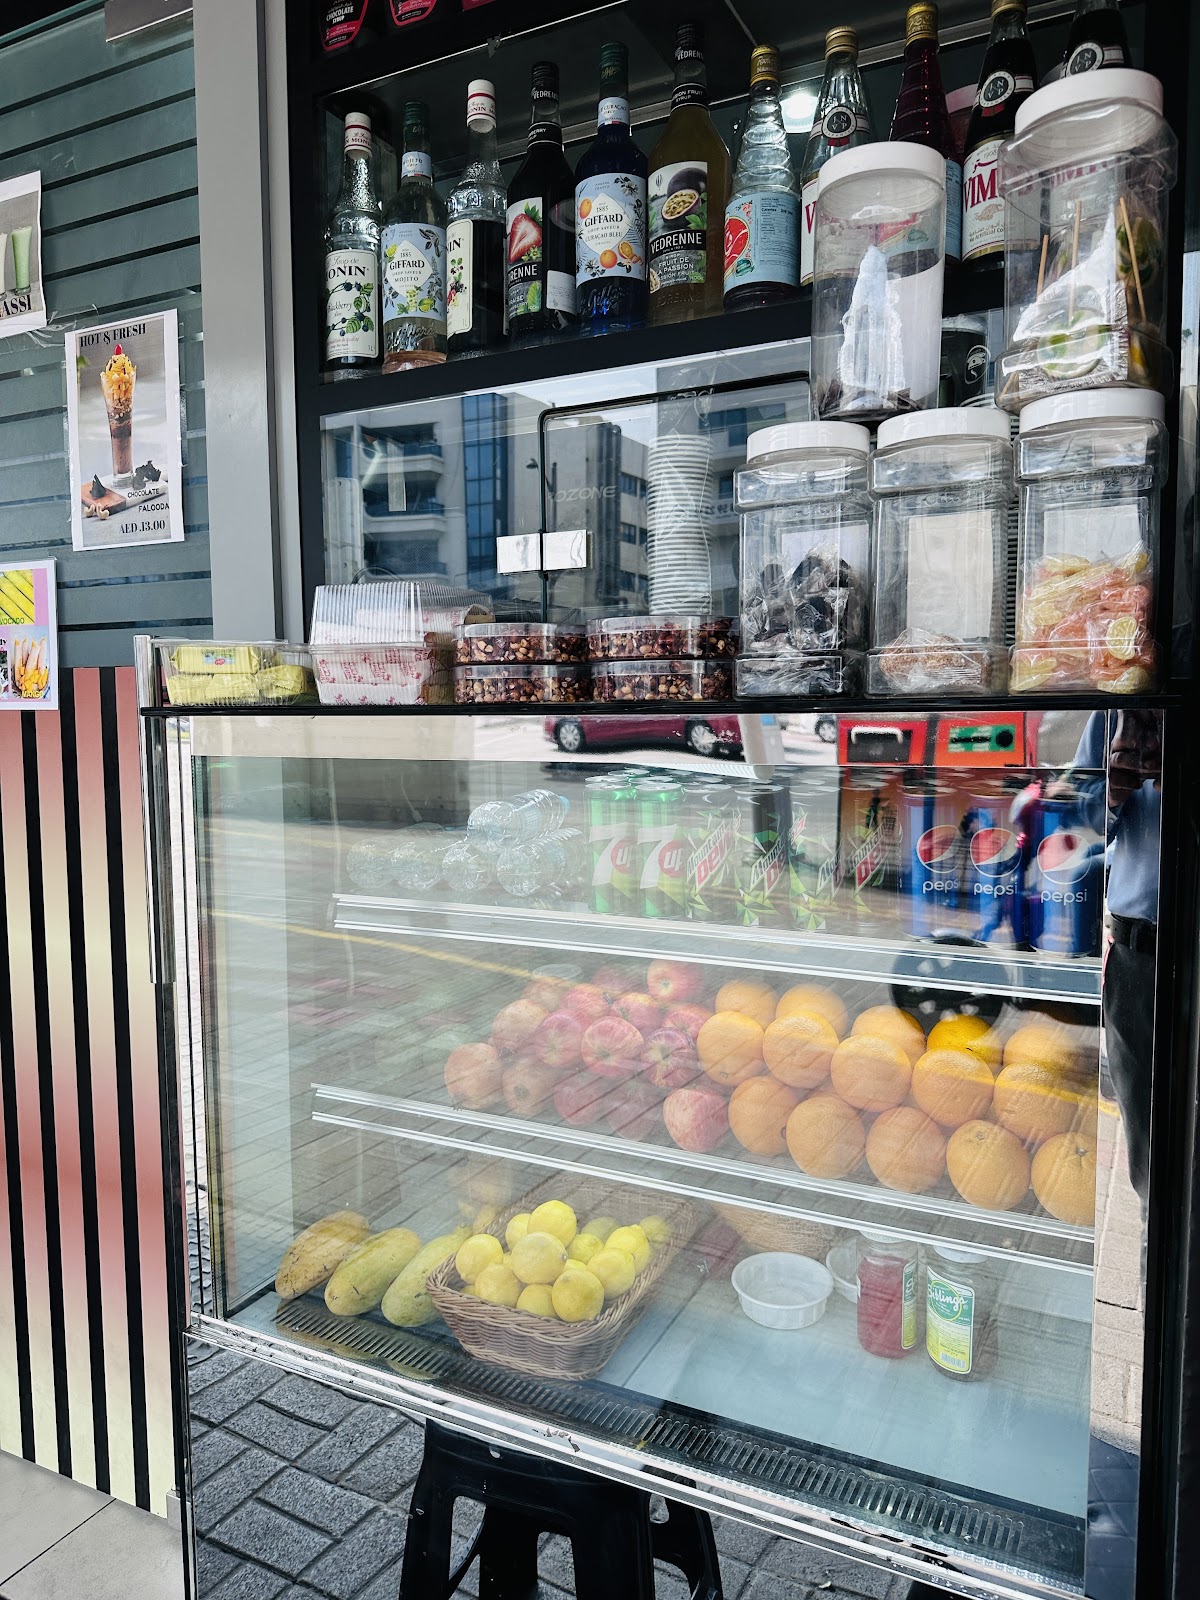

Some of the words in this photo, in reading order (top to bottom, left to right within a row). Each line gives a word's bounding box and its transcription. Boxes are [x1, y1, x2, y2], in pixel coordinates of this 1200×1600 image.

[326, 5, 354, 21] CHOCOLATE
[677, 49, 704, 60] VEDREN
[531, 88, 557, 100] VEDREN
[584, 213, 624, 228] GIFFARD
[651, 232, 703, 255] VEDRENNE
[400, 251, 412, 259] 1885
[389, 259, 425, 271] GIFFARD
[658, 258, 678, 269] FRUIT
[663, 263, 694, 274] PASSION
[0, 294, 32, 318] ASSI
[80, 333, 102, 348] HOT
[103, 330, 111, 345] &
[113, 322, 146, 341] FRESH
[127, 487, 160, 499] CHOCOLATE
[138, 502, 170, 513] FALOODA
[120, 522, 138, 534] AED
[21, 690, 43, 698] MANGO
[687, 820, 726, 881] Mountain
[973, 882, 1018, 899] pepsi
[1040, 888, 1088, 907] pepsi
[927, 1284, 968, 1312] Siblings
